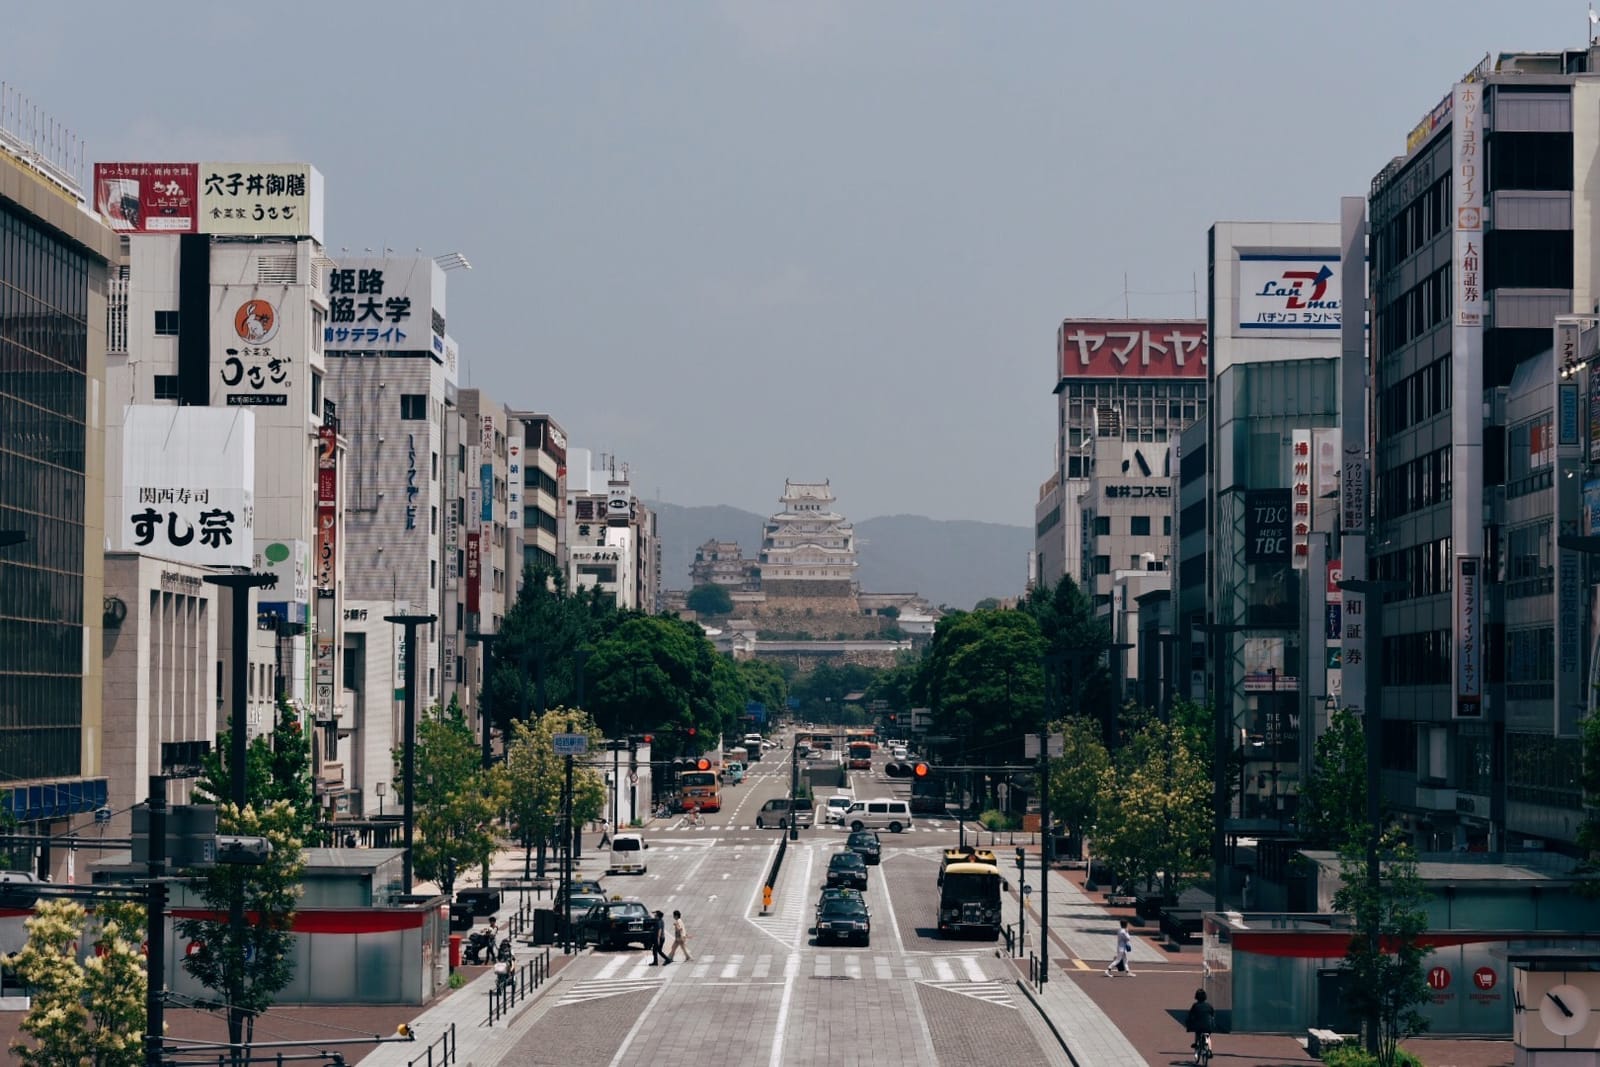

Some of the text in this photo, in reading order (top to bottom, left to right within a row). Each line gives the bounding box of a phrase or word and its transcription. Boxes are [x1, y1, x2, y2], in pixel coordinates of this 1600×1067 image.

[204, 173, 305, 196] 穴子丼御膳
[252, 204, 296, 221] うさぎ
[329, 268, 384, 294] 姫路
[1464, 242, 1479, 302] 大和証券
[325, 296, 411, 323] 協大学
[1257, 313, 1297, 323] パチンコ
[220, 348, 291, 389] うさぎ
[139, 487, 209, 504] 関西寿司
[509, 464, 519, 520] 第一生命
[1105, 485, 1171, 498] 岩井コスモ
[1294, 441, 1309, 557] 播州信用金庫
[131, 507, 235, 549] すし宗
[1255, 507, 1287, 524] TBC
[1256, 538, 1287, 554] TBC
[1346, 576, 1362, 665] 和証券
